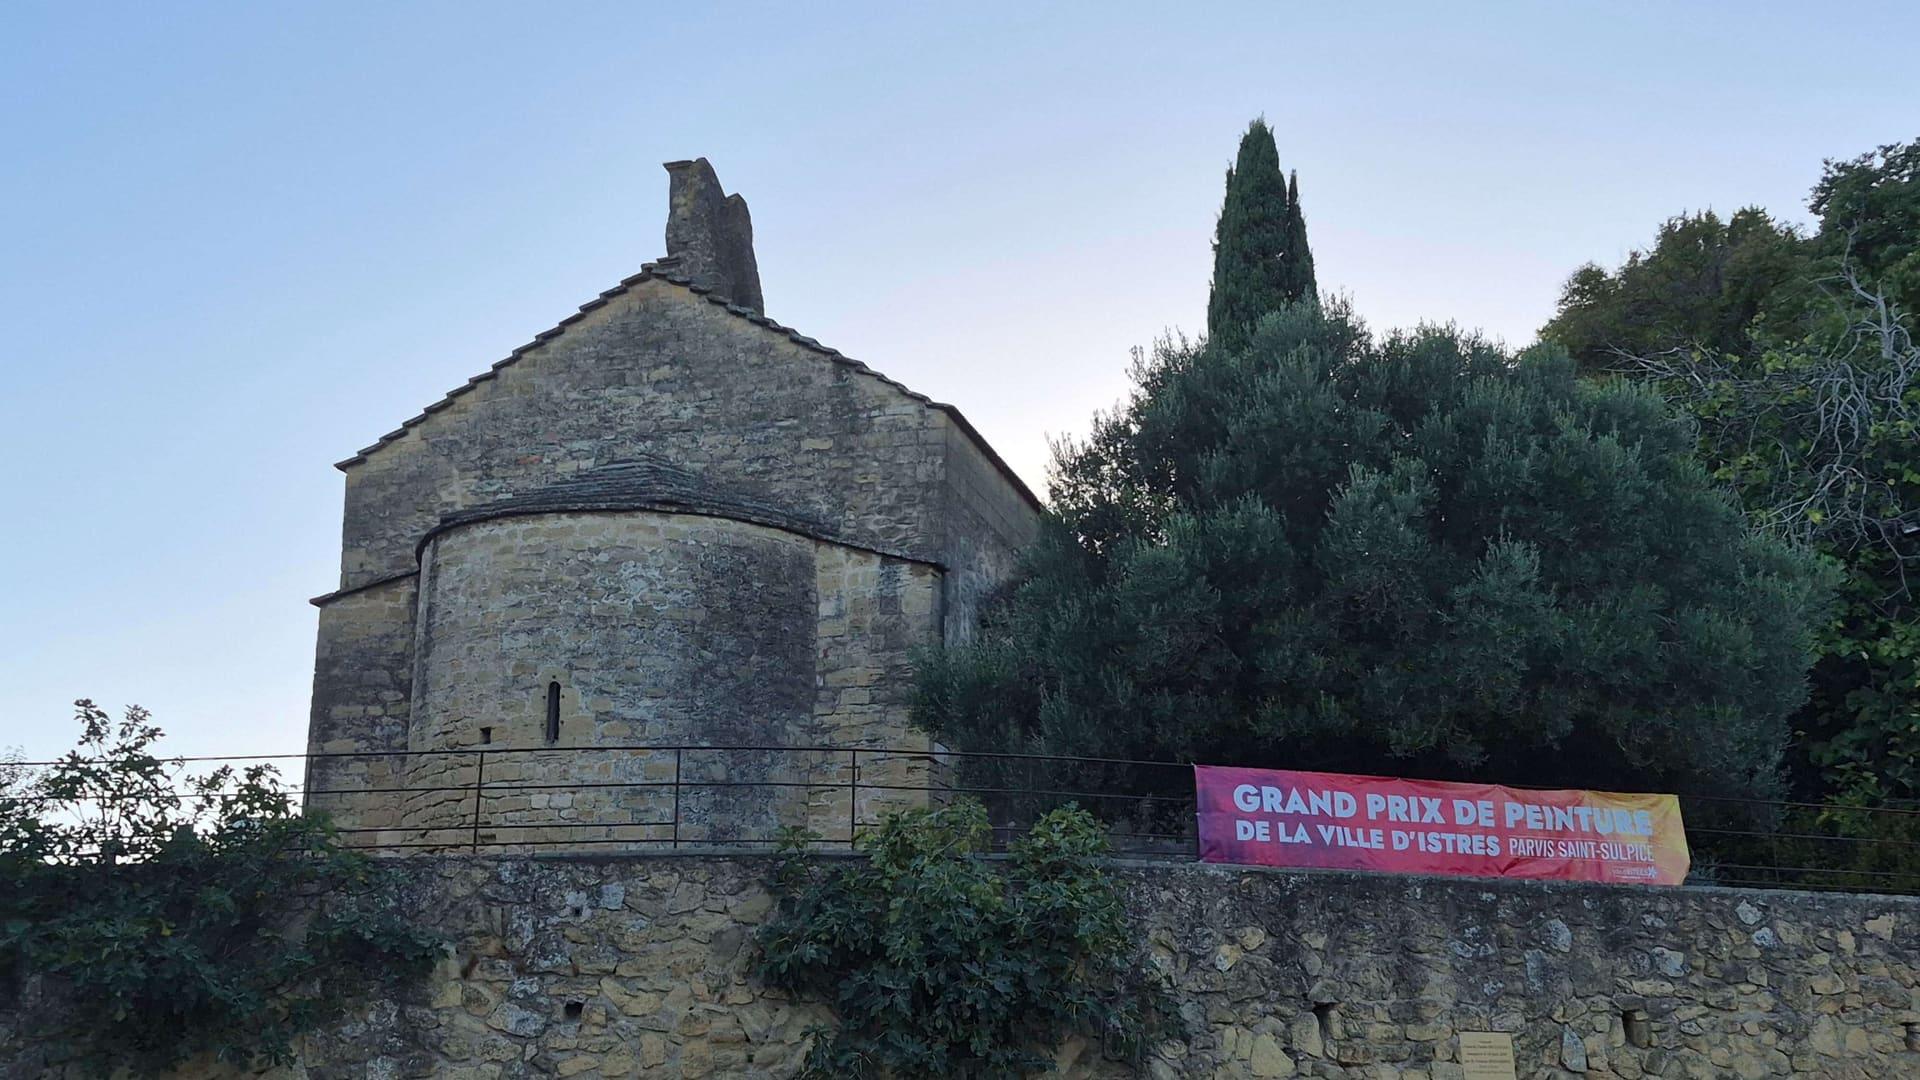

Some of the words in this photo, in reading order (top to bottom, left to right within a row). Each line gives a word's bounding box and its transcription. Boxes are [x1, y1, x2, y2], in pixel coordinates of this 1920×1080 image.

[1233, 784, 1357, 818] GRAND
[1367, 793, 1446, 824] PRIX
[1453, 799, 1496, 828] DE
[1504, 802, 1653, 836] PEINTURE
[1236, 820, 1270, 842] DE
[1279, 822, 1312, 844] LA
[1317, 824, 1385, 850] VILLE
[1392, 830, 1501, 857] D'ISTRES
[1509, 838, 1555, 858] PARVIS
[1558, 840, 1655, 862] SAINT-SULPICE
